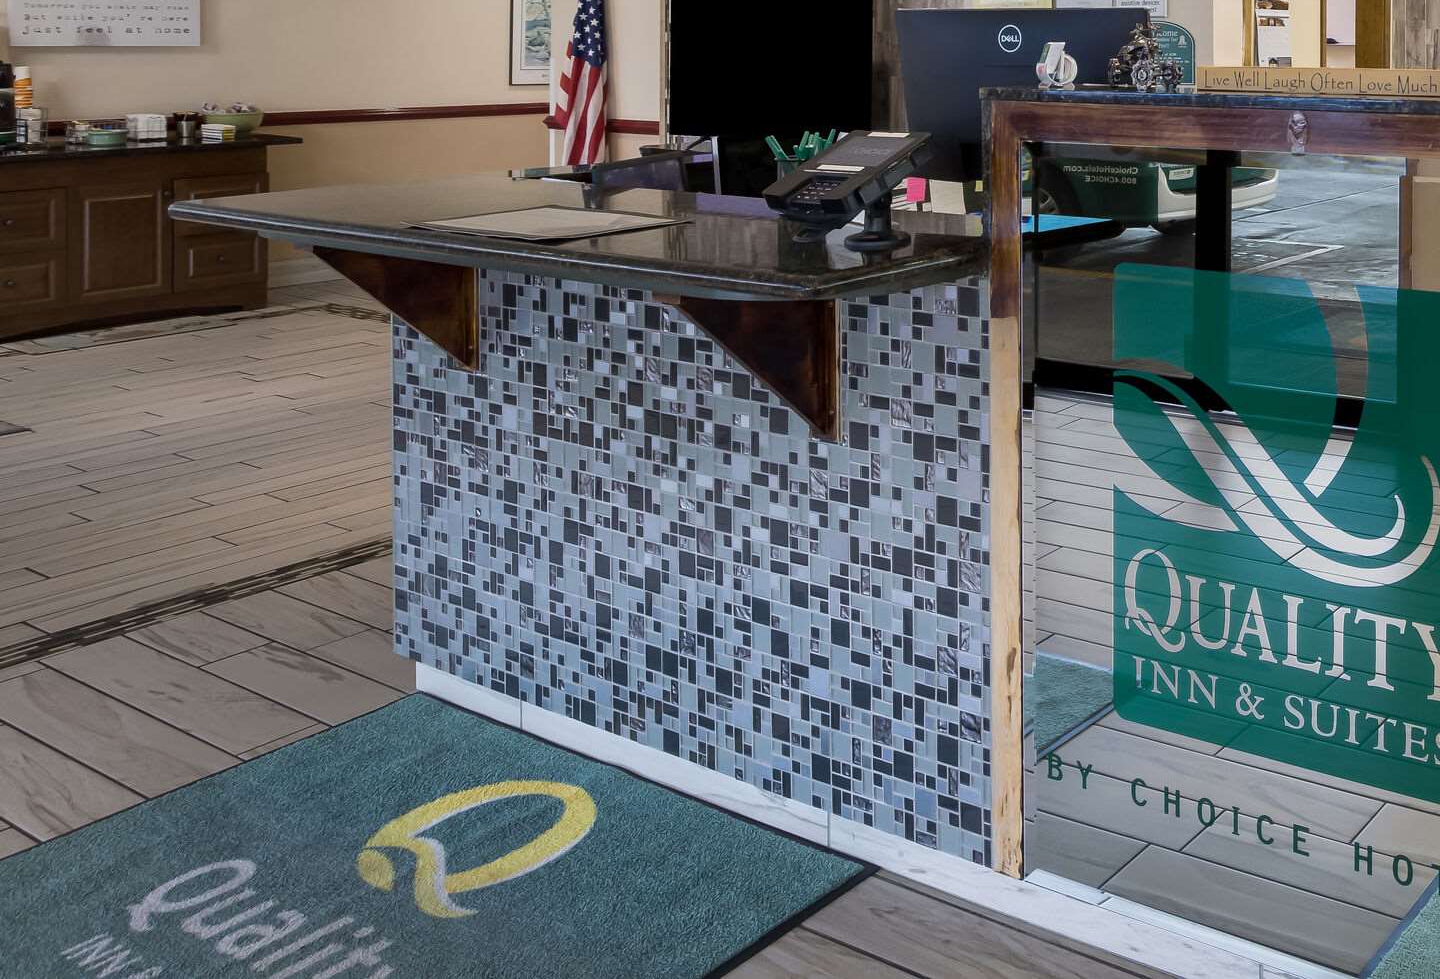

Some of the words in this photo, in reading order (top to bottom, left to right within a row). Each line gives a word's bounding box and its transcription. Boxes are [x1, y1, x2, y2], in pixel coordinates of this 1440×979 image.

[1204, 70, 1230, 88] Live
[1234, 71, 1259, 87] Well
[1264, 72, 1305, 91] Laugh
[1311, 72, 1353, 91] Often
[1359, 74, 1392, 93] Love
[1398, 75, 1437, 93] Much
[1132, 655, 1217, 710] INN
[1235, 683, 1265, 721] &
[1047, 753, 1093, 791] BY
[1130, 777, 1311, 857] CHOICE
